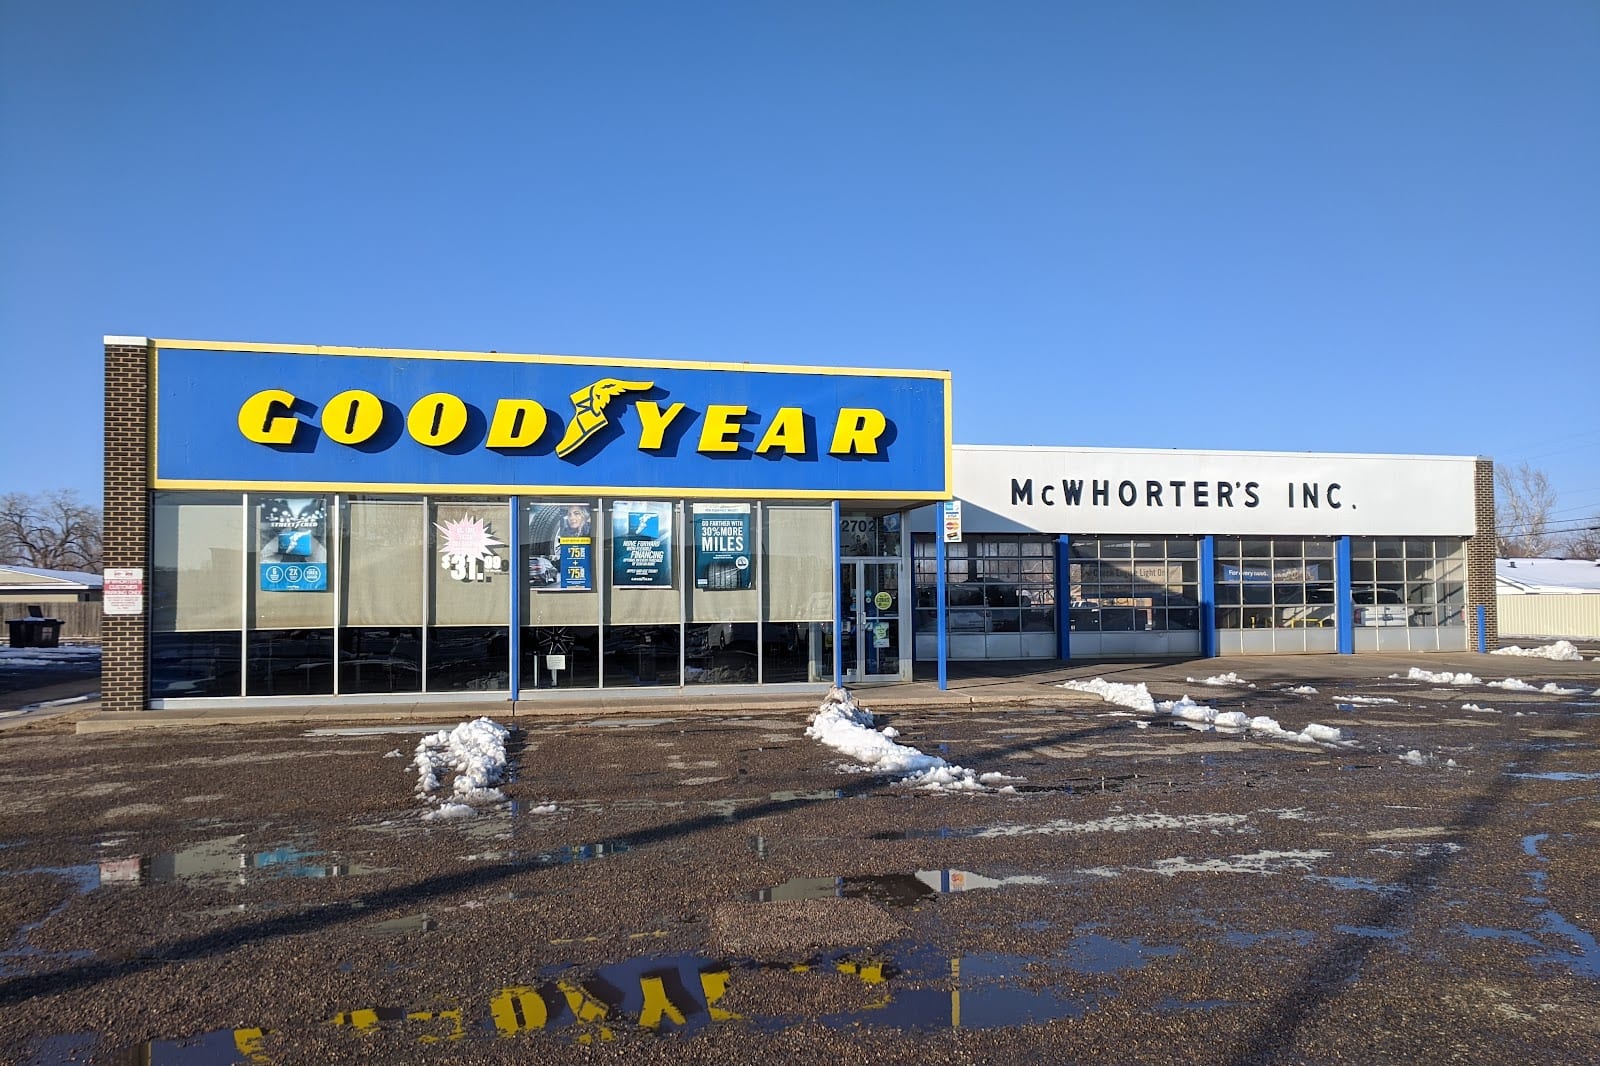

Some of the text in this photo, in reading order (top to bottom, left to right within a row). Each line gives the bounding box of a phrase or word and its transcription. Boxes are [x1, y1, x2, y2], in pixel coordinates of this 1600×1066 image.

[237, 388, 887, 454] GOODYEAR
[1010, 478, 1358, 510] McWHORTER'S INC.
[702, 527, 743, 536] 30% MORE
[702, 537, 744, 551] MILES
[630, 551, 664, 559] FINANCING
[1140, 568, 1156, 578] Light
